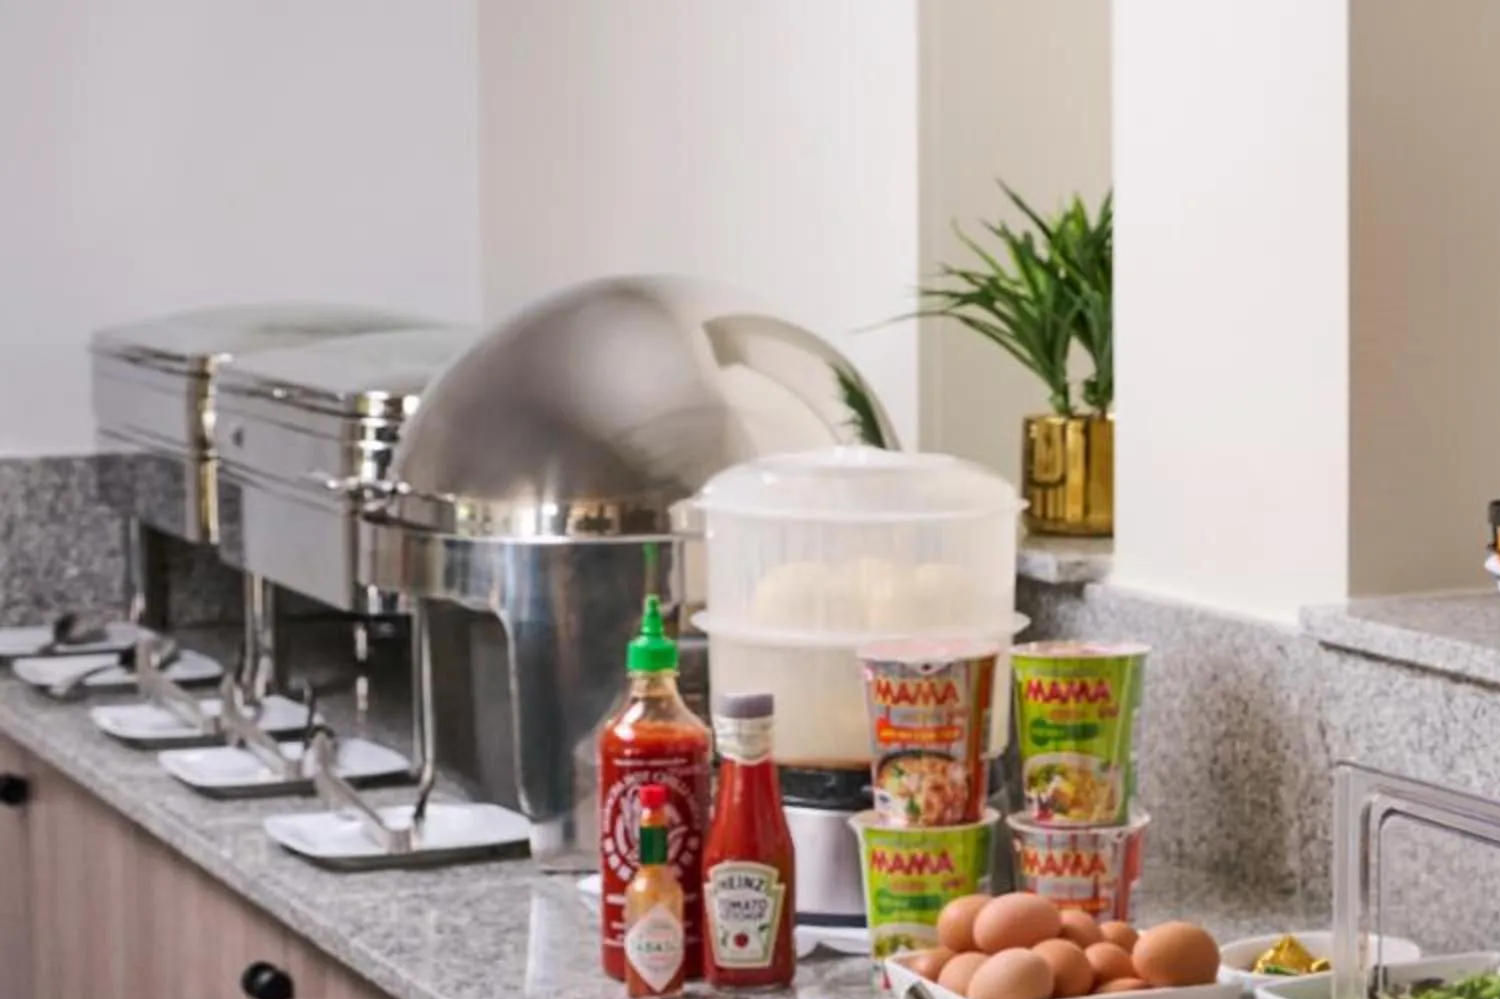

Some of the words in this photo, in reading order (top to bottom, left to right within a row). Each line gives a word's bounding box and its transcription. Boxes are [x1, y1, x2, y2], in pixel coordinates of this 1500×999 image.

[874, 677, 961, 706] MAMA
[1024, 677, 1112, 705] MAMA
[870, 847, 955, 875] MAMA
[1021, 847, 1107, 877] MAMA
